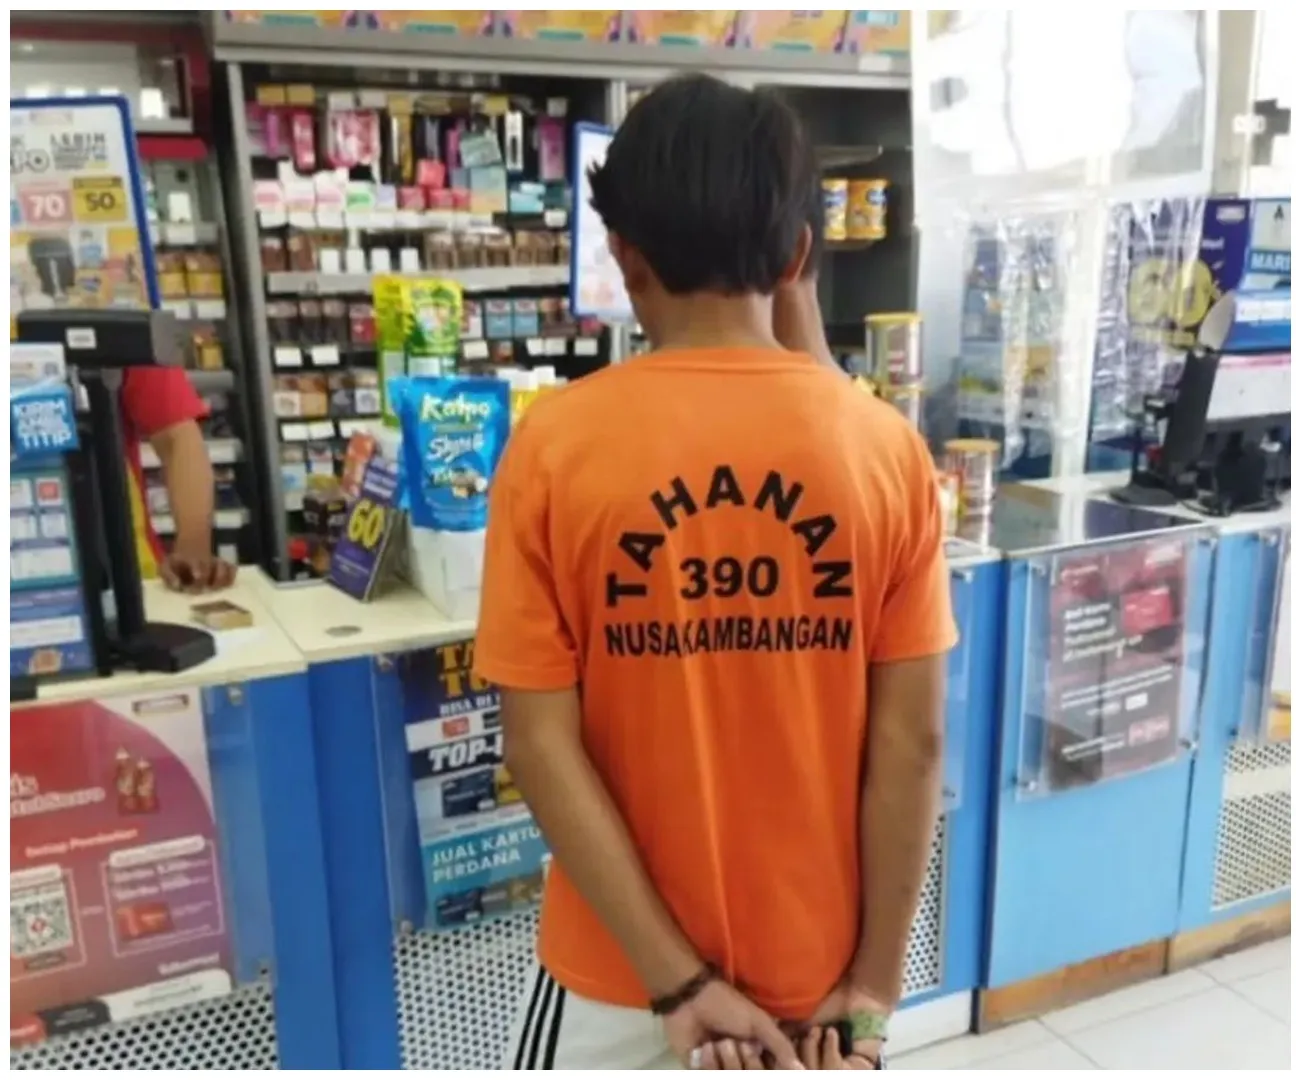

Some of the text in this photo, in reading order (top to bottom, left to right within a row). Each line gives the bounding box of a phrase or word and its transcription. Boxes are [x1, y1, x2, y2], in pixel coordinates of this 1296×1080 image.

[29, 192, 116, 220] 70 50
[348, 499, 385, 549] 60
[605, 464, 854, 608] TAHANAN
[679, 556, 779, 600] 390
[604, 614, 854, 658] NUSAKAMBANGAN
[432, 840, 477, 867] JUAL
[481, 825, 542, 851] KARTU
[432, 850, 522, 883] PERDANA
